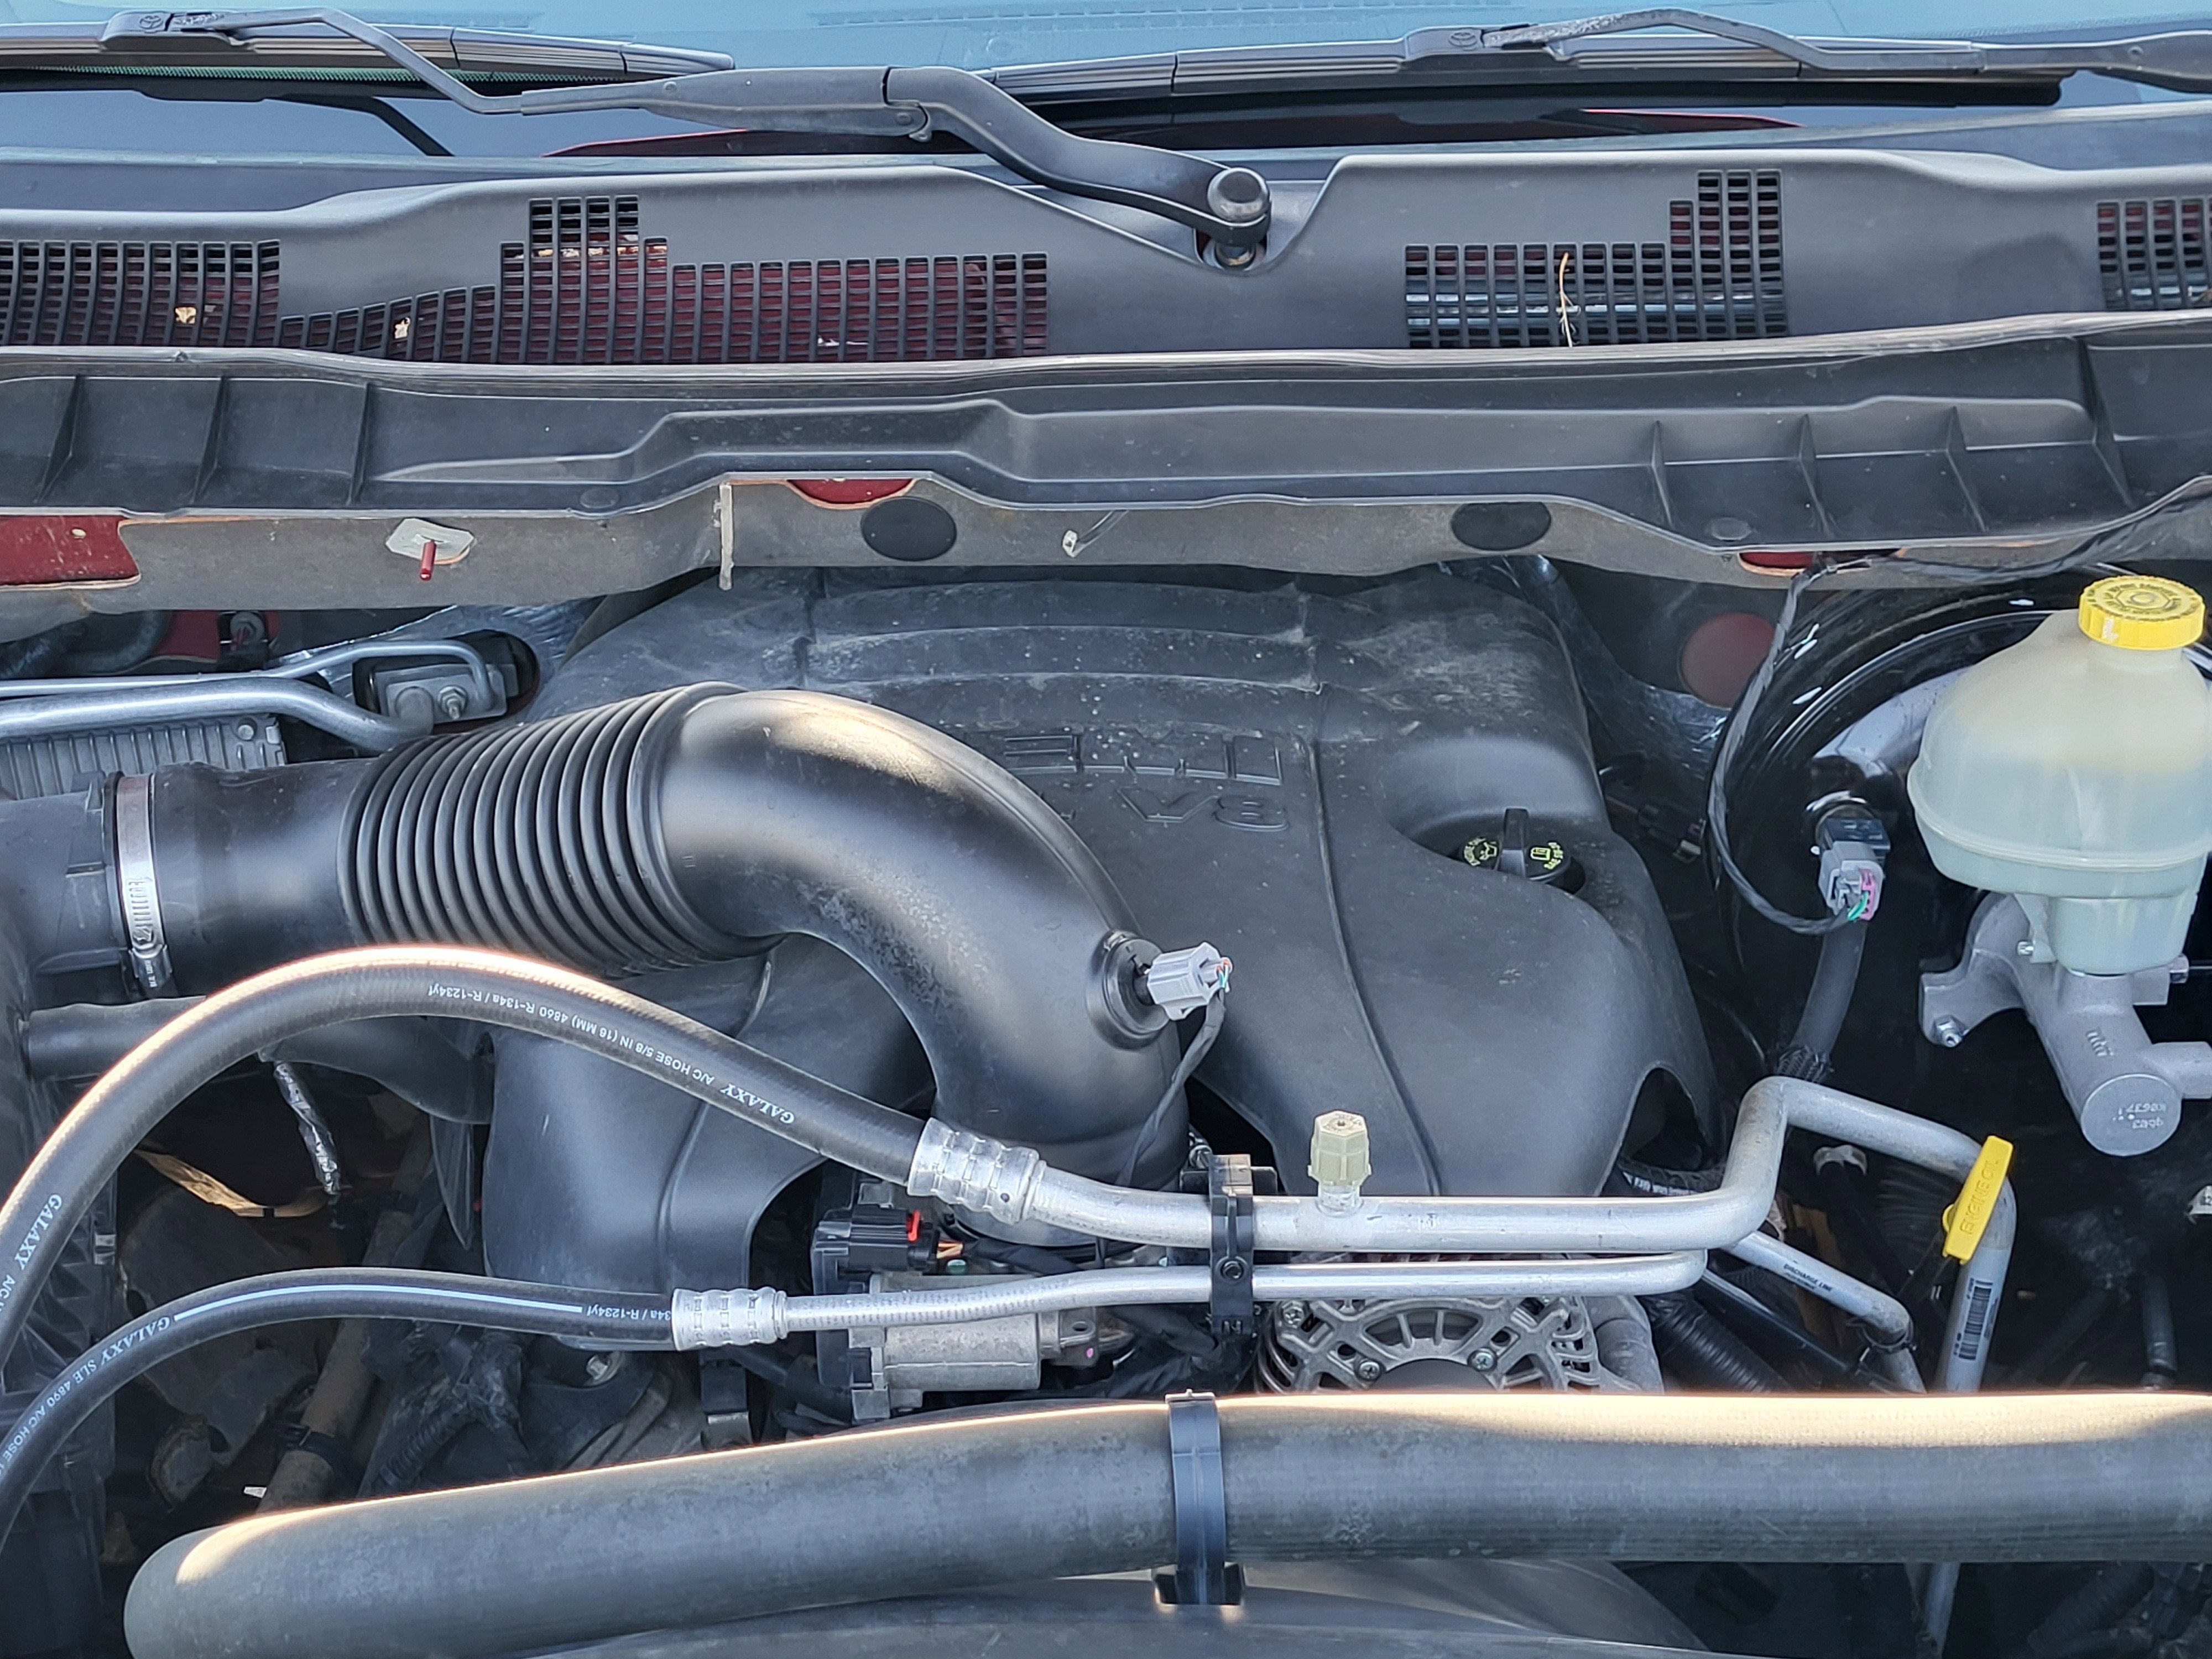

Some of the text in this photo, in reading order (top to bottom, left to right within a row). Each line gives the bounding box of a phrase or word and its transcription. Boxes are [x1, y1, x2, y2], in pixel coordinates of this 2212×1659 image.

[976, 727, 1284, 786] EMI
[1117, 786, 1288, 831] V8
[428, 983, 795, 1124] GALAXY A/C HOSE 5/8 IN (16 MM) 4860 R-134a / R-1234yf
[14, 1193, 62, 1270] GALAXY
[1959, 1180, 1988, 1234] ENGINE
[587, 1305, 640, 1320] R-1234yf
[650, 1310, 671, 1321] 34a
[3, 1315, 171, 1462] GALAXY SLE 4890 A/C HOSE
